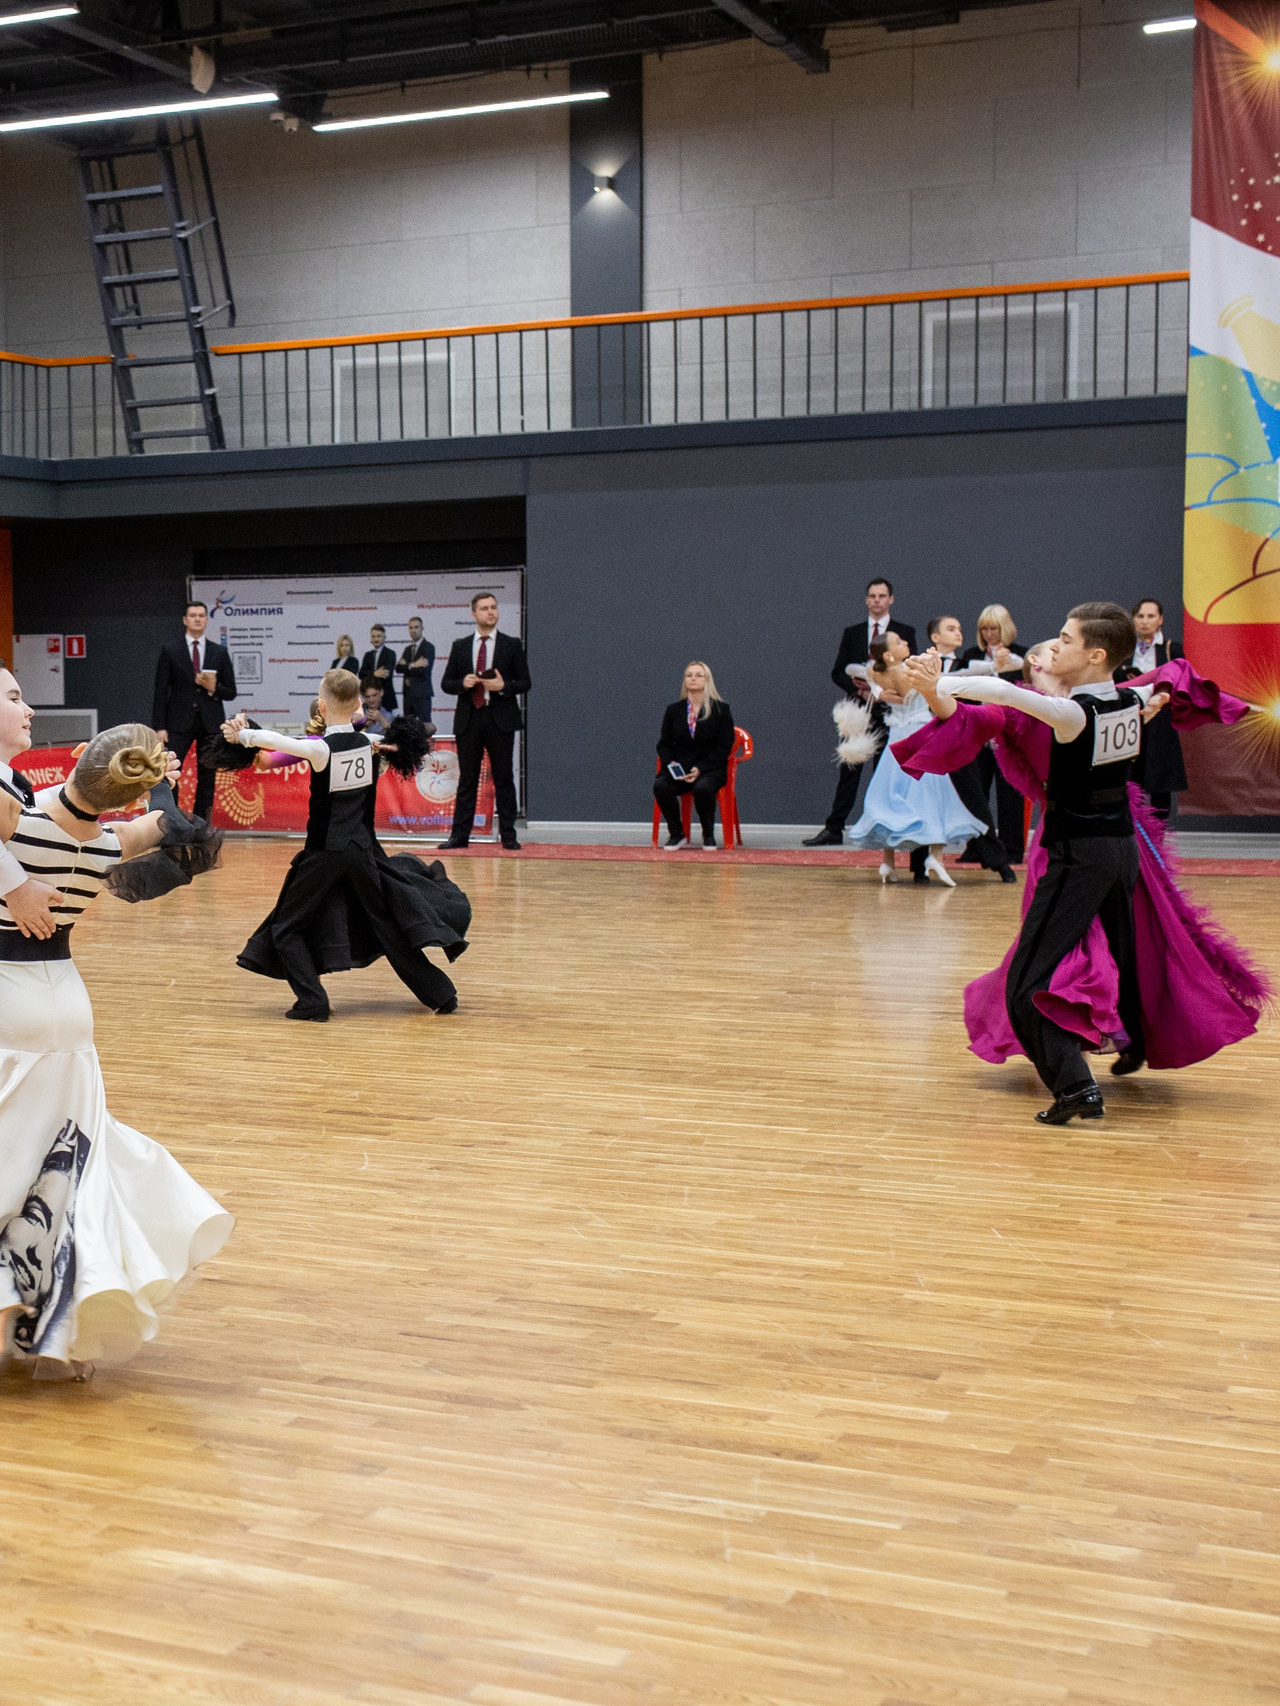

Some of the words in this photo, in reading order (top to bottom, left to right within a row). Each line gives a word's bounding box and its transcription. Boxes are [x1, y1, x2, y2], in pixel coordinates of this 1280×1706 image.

[224, 606, 283, 617] Олимпия
[1100, 718, 1138, 753] 103
[340, 757, 366, 782] 78
